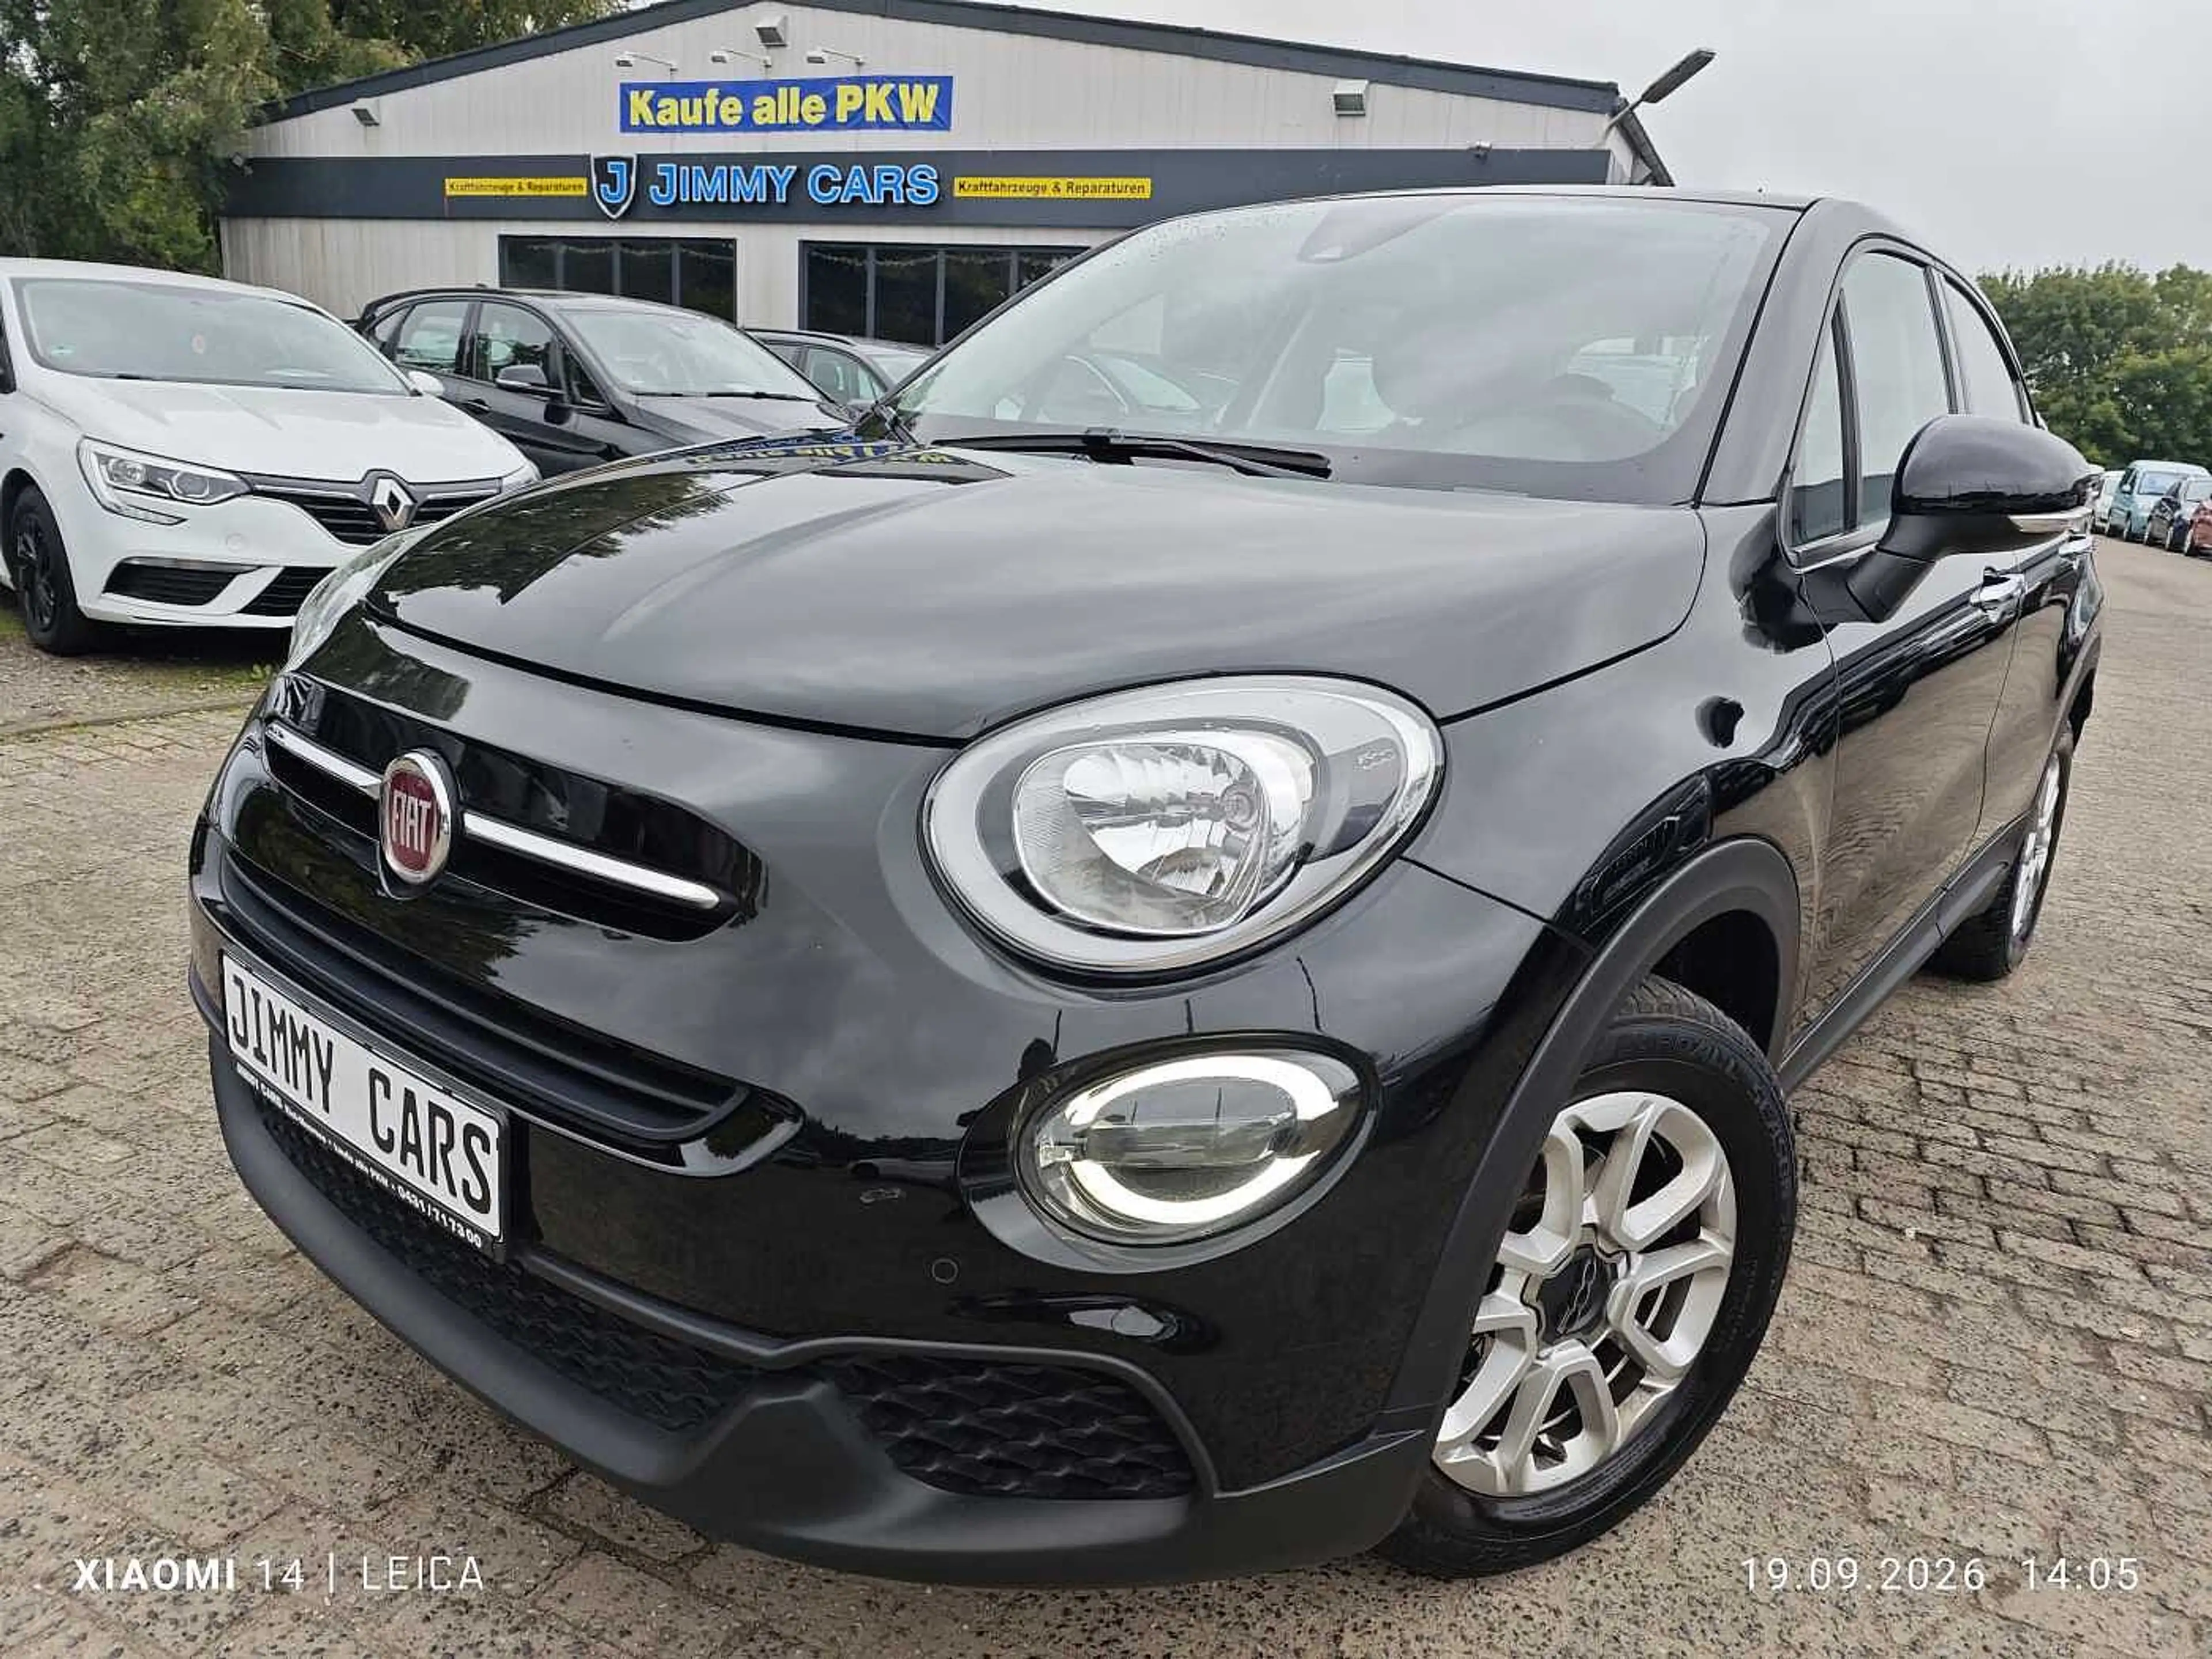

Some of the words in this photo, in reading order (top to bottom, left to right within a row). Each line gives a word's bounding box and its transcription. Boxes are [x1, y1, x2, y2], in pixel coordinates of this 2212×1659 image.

[629, 89, 743, 126] Kaufe
[752, 87, 827, 125] alle
[835, 82, 939, 123] PKW
[600, 161, 628, 203] J
[649, 163, 797, 206] JIMMY
[808, 164, 939, 206] CARS
[958, 180, 1047, 195] Kraftfahrzeuge
[1051, 181, 1062, 193] &
[1066, 180, 1145, 196] Reparaturen
[392, 789, 432, 854] FIAT
[232, 974, 334, 1114] JIMMY
[368, 1067, 491, 1215] CARS
